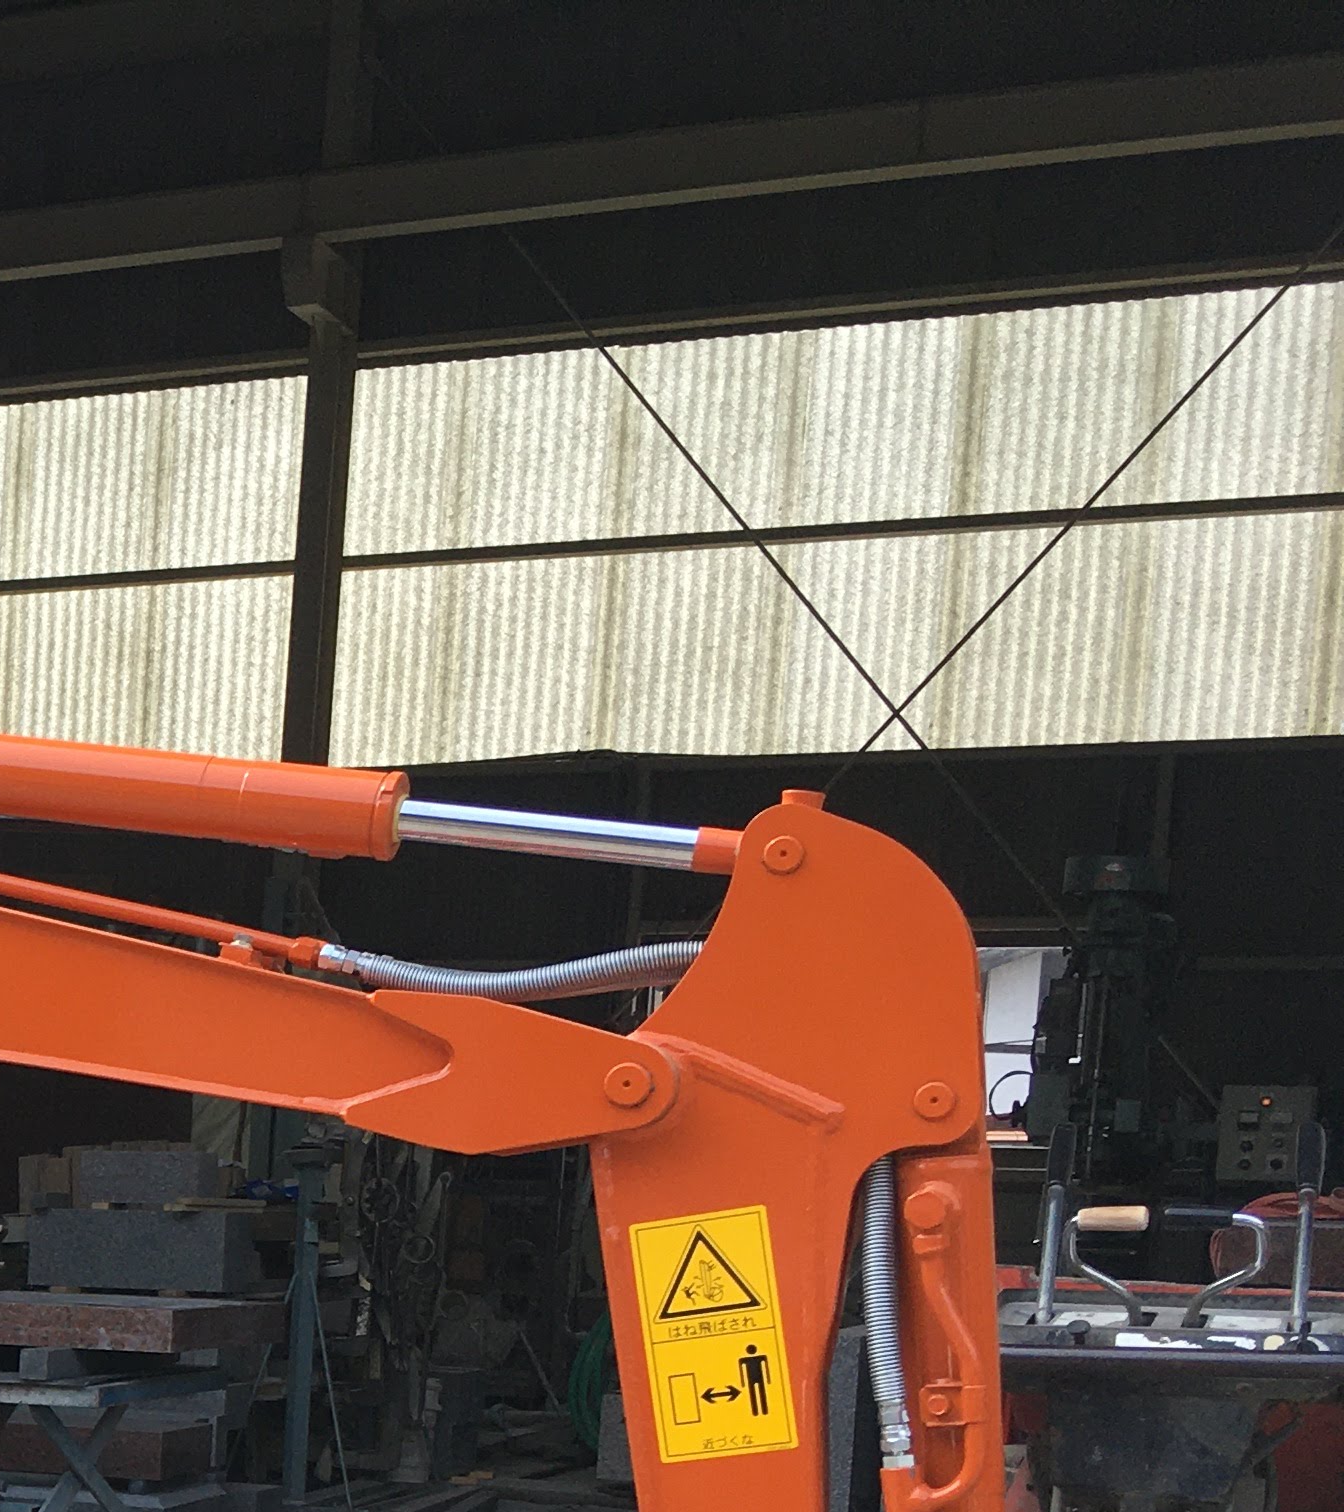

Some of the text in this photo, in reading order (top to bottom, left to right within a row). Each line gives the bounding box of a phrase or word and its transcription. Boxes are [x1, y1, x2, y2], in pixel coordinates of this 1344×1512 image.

[668, 1316, 757, 1338] はね飛ばされ
[702, 1434, 754, 1449] 近づくな
